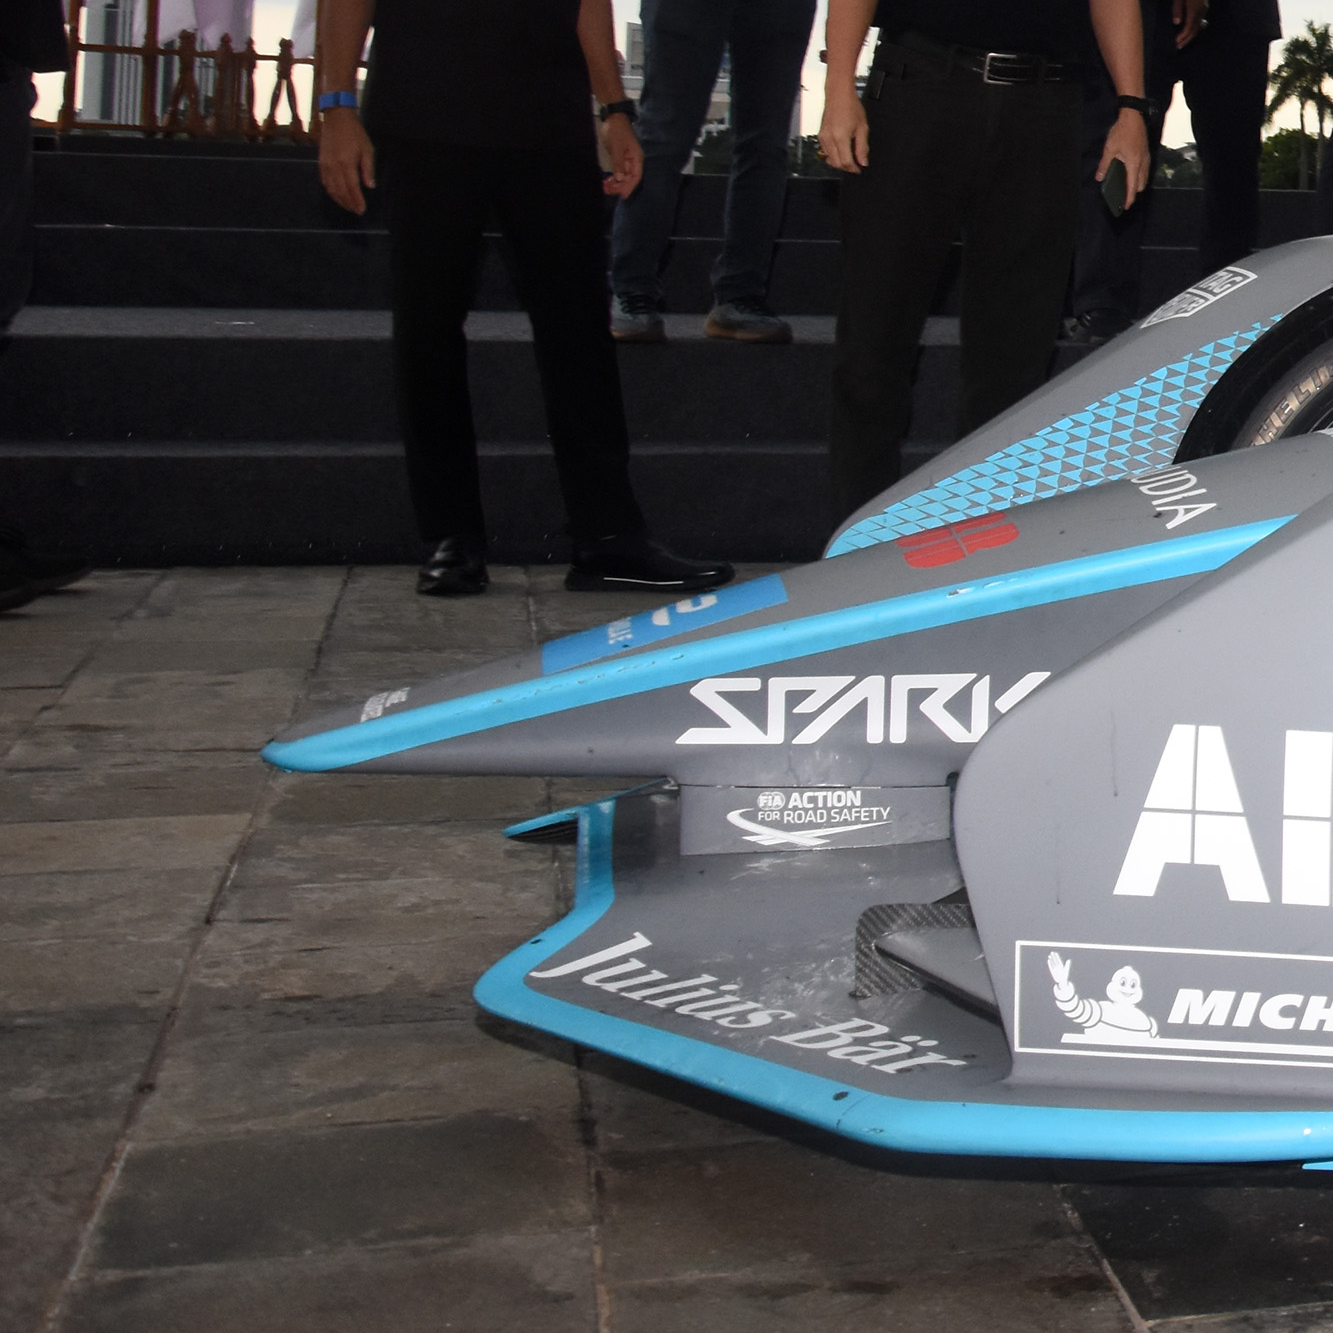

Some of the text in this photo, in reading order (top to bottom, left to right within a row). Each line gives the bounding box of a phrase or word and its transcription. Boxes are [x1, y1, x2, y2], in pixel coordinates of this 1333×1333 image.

[674, 671, 1051, 745] SPARK
[758, 790, 861, 810] FIA ACTION
[758, 806, 891, 824] FOR ROAD SAFETY
[528, 931, 968, 1074] Julius Bär
